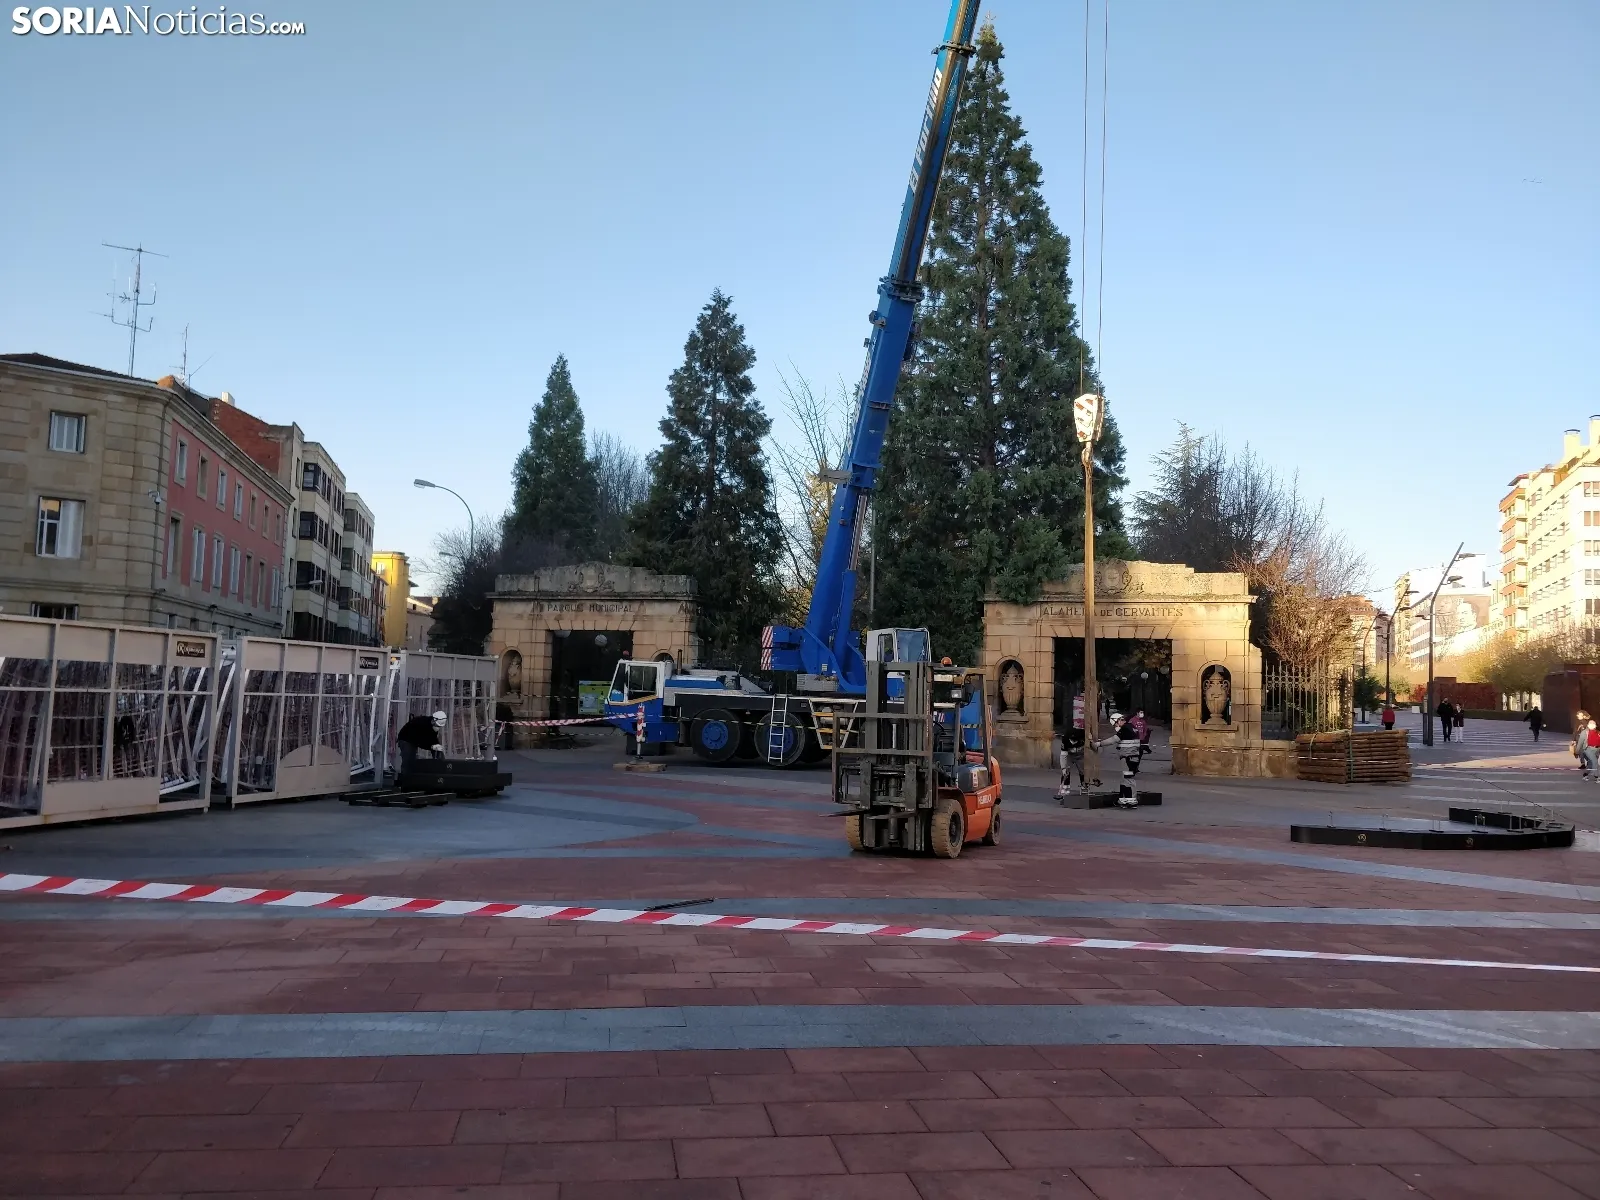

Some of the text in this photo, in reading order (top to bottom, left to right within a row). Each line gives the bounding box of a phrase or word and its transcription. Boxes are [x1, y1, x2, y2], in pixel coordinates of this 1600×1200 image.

[547, 602, 634, 613] PARQUE MUNICIPAL
[1100, 608, 1113, 617] DE
[1115, 606, 1184, 617] CERVANTES
